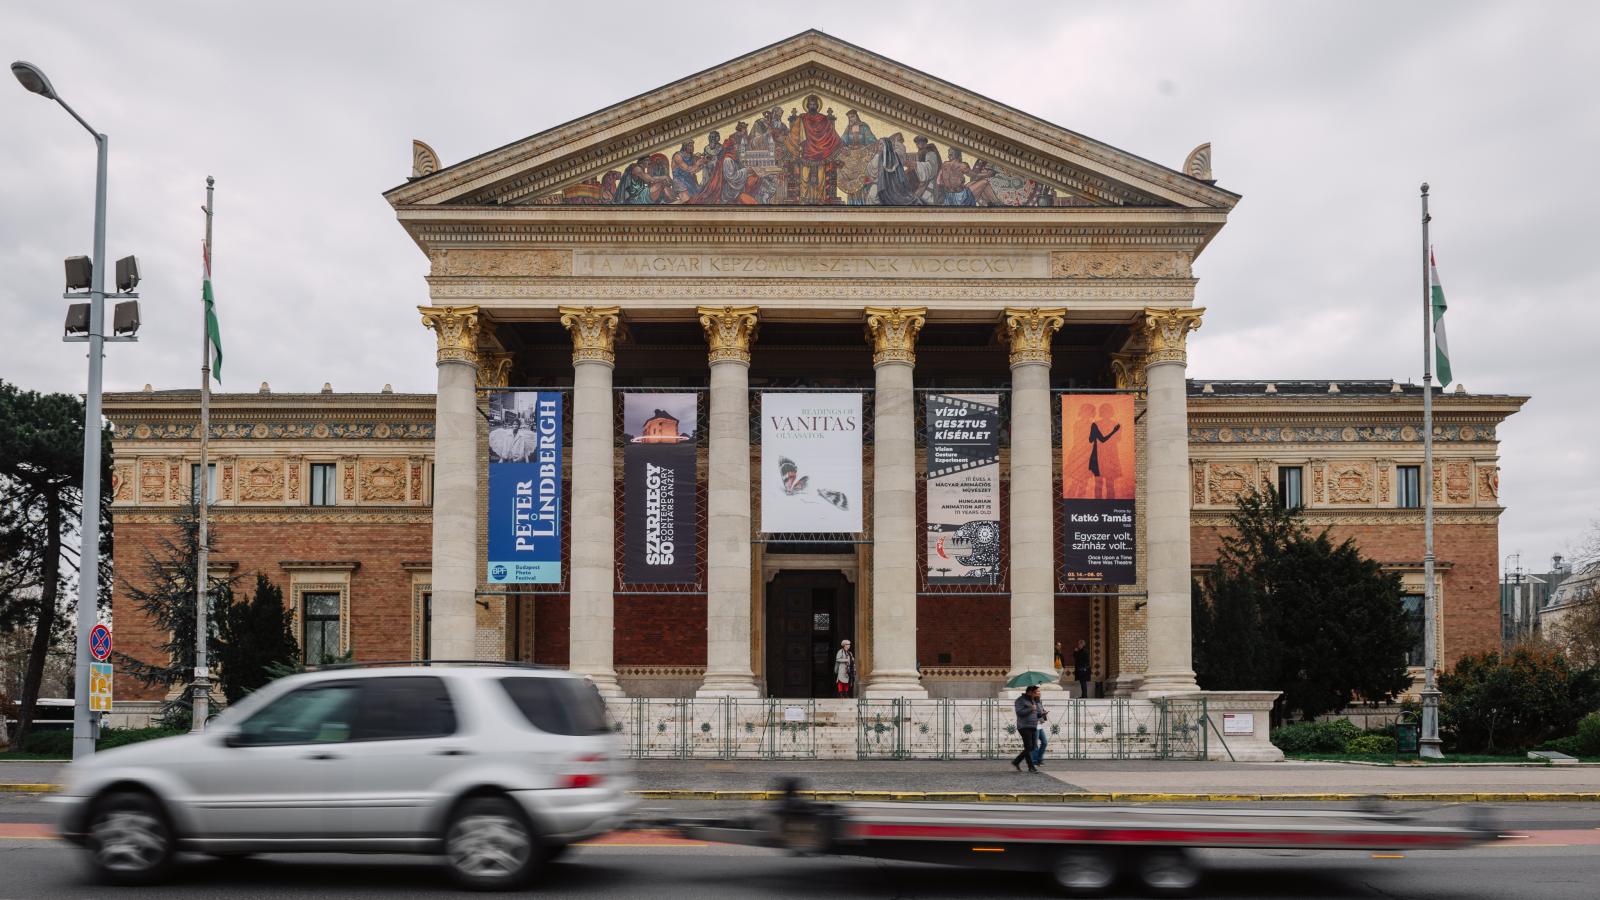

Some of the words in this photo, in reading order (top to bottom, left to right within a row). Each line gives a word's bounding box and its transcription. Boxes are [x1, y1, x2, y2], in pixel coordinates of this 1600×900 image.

[601, 257, 612, 272] A
[623, 257, 700, 272] MAGYAR
[934, 406, 968, 417] VÍZIÓ
[770, 416, 856, 431] VANITAS
[934, 420, 987, 429] GESZTUS
[934, 430, 991, 440] KÍSÉRLET
[533, 400, 556, 537] LINDBERGH
[515, 480, 534, 552] PETER
[1071, 513, 1100, 522] Katkó
[1101, 513, 1132, 522] Tamás
[1074, 532, 1111, 542] Egyszer
[1113, 532, 1133, 541] volt,
[1072, 541, 1106, 550] színház
[660, 541, 675, 565] 50
